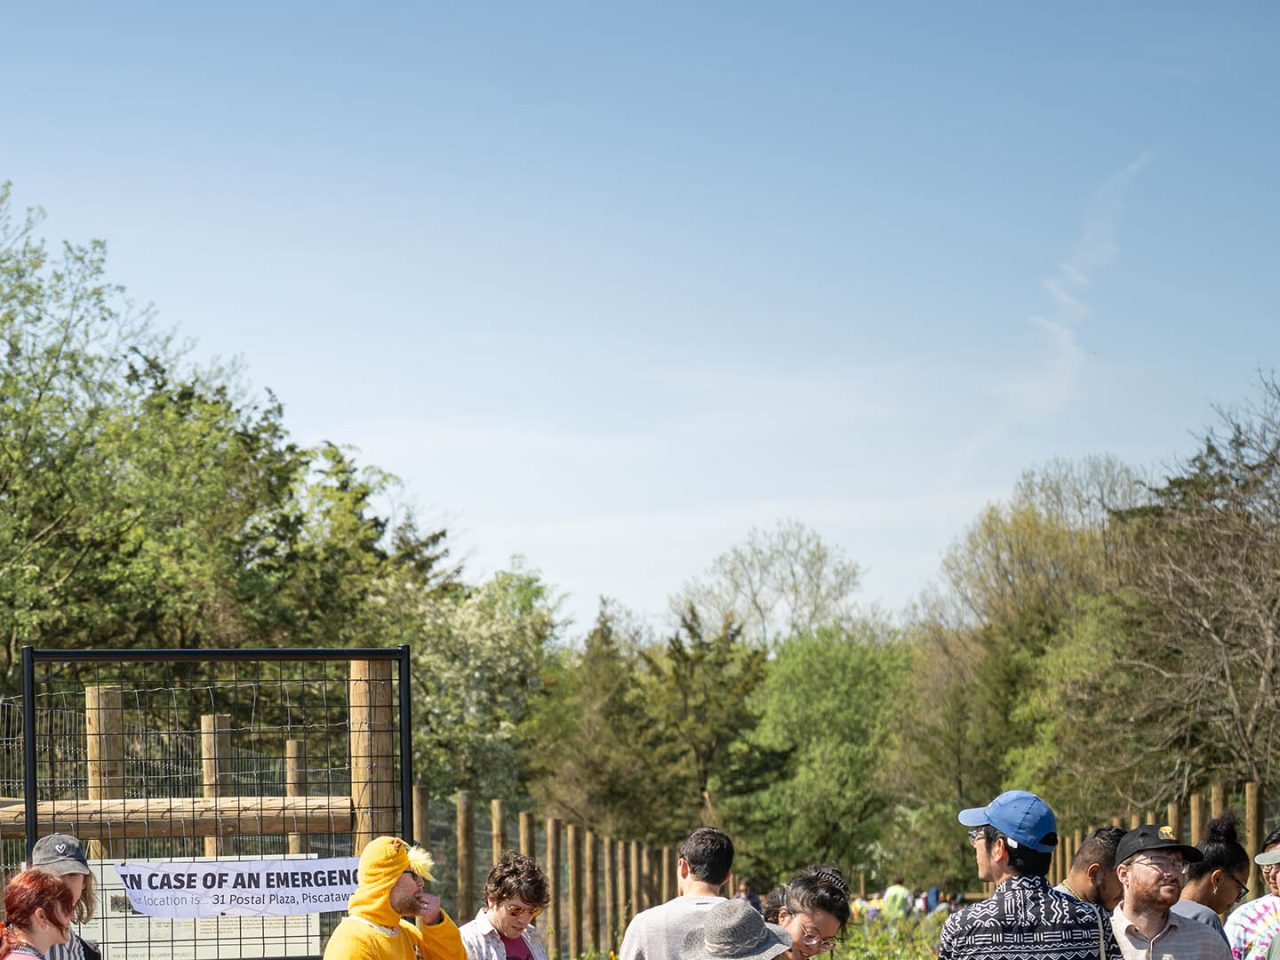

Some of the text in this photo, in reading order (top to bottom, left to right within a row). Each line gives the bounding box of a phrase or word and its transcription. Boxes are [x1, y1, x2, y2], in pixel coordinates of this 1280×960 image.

[120, 869, 359, 890] IN CASE OF AN EMERGENC
[143, 895, 187, 906] location
[212, 894, 226, 905] 31
[229, 894, 265, 905] Postal
[269, 893, 299, 905] Plaza,
[302, 892, 356, 904] Piscataw
